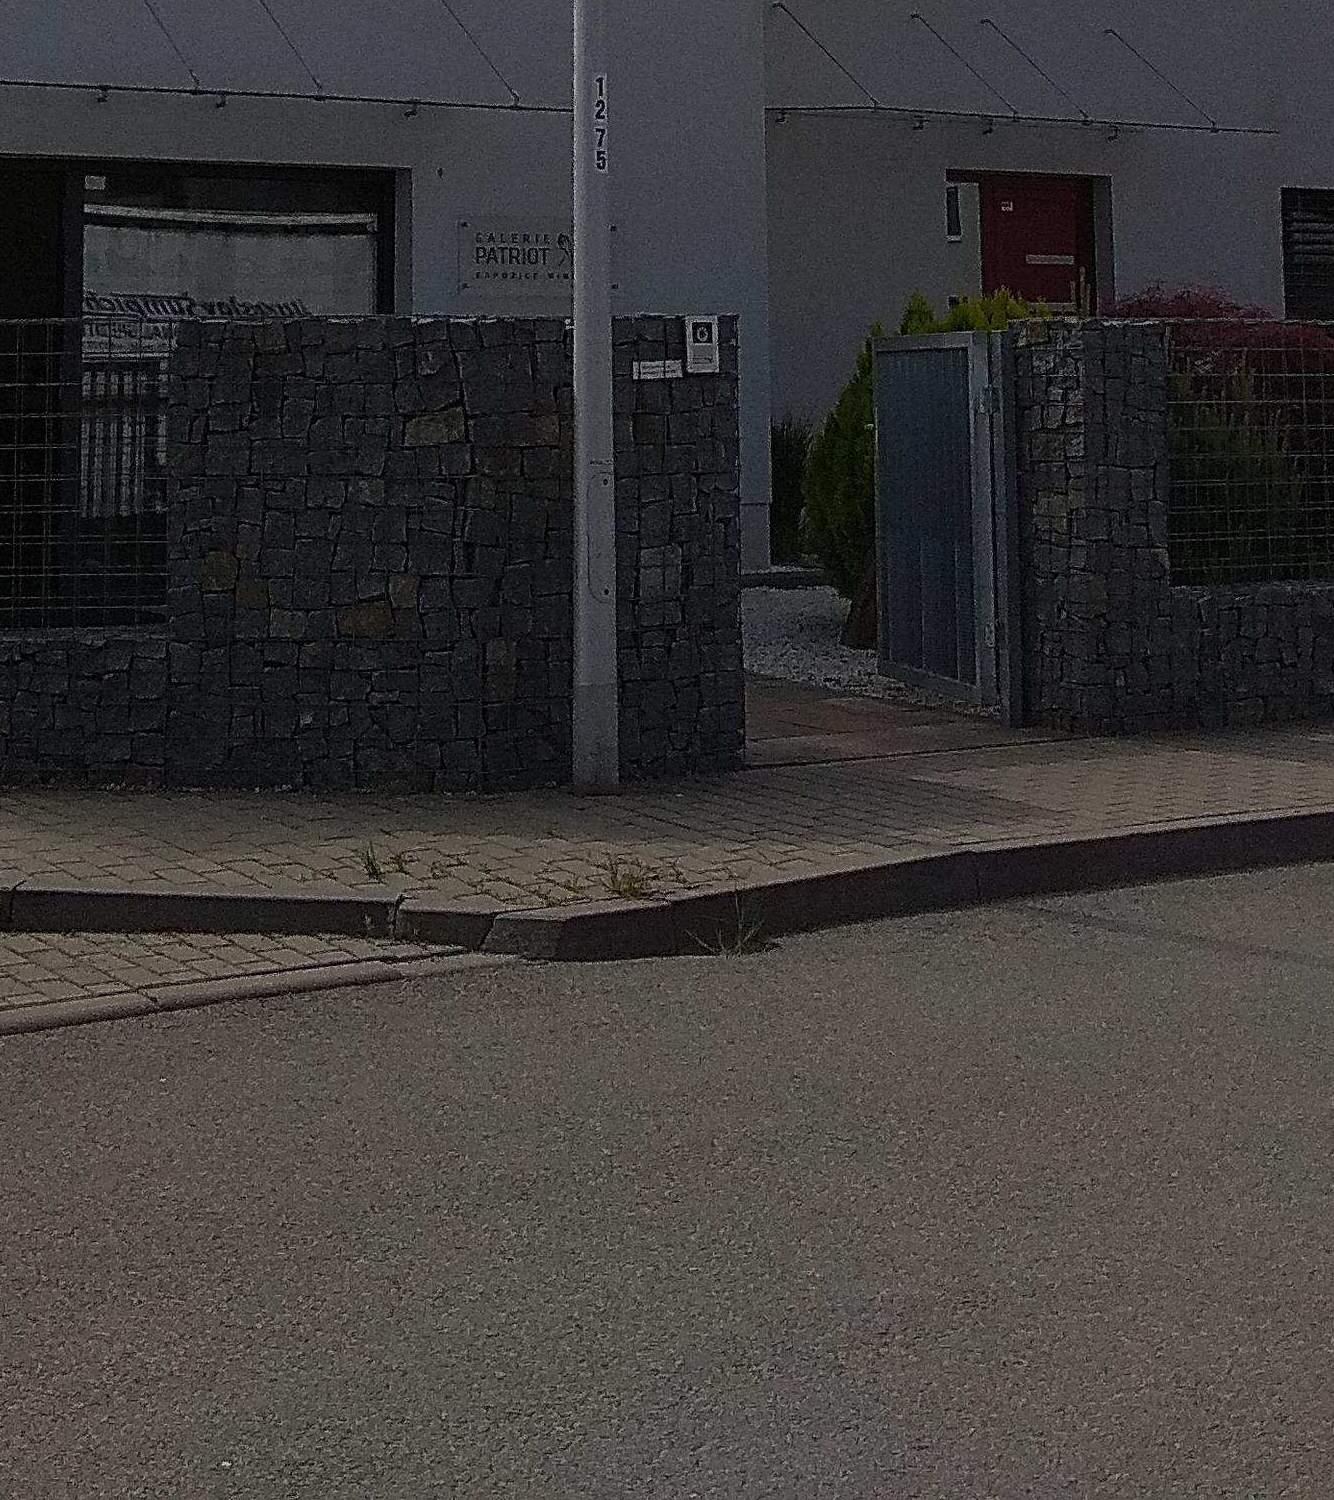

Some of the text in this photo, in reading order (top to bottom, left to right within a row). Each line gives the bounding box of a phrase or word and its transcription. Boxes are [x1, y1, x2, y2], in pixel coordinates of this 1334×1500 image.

[594, 77, 607, 171] 1275
[475, 231, 552, 245] GALERIE
[475, 246, 552, 266] PATRIOT
